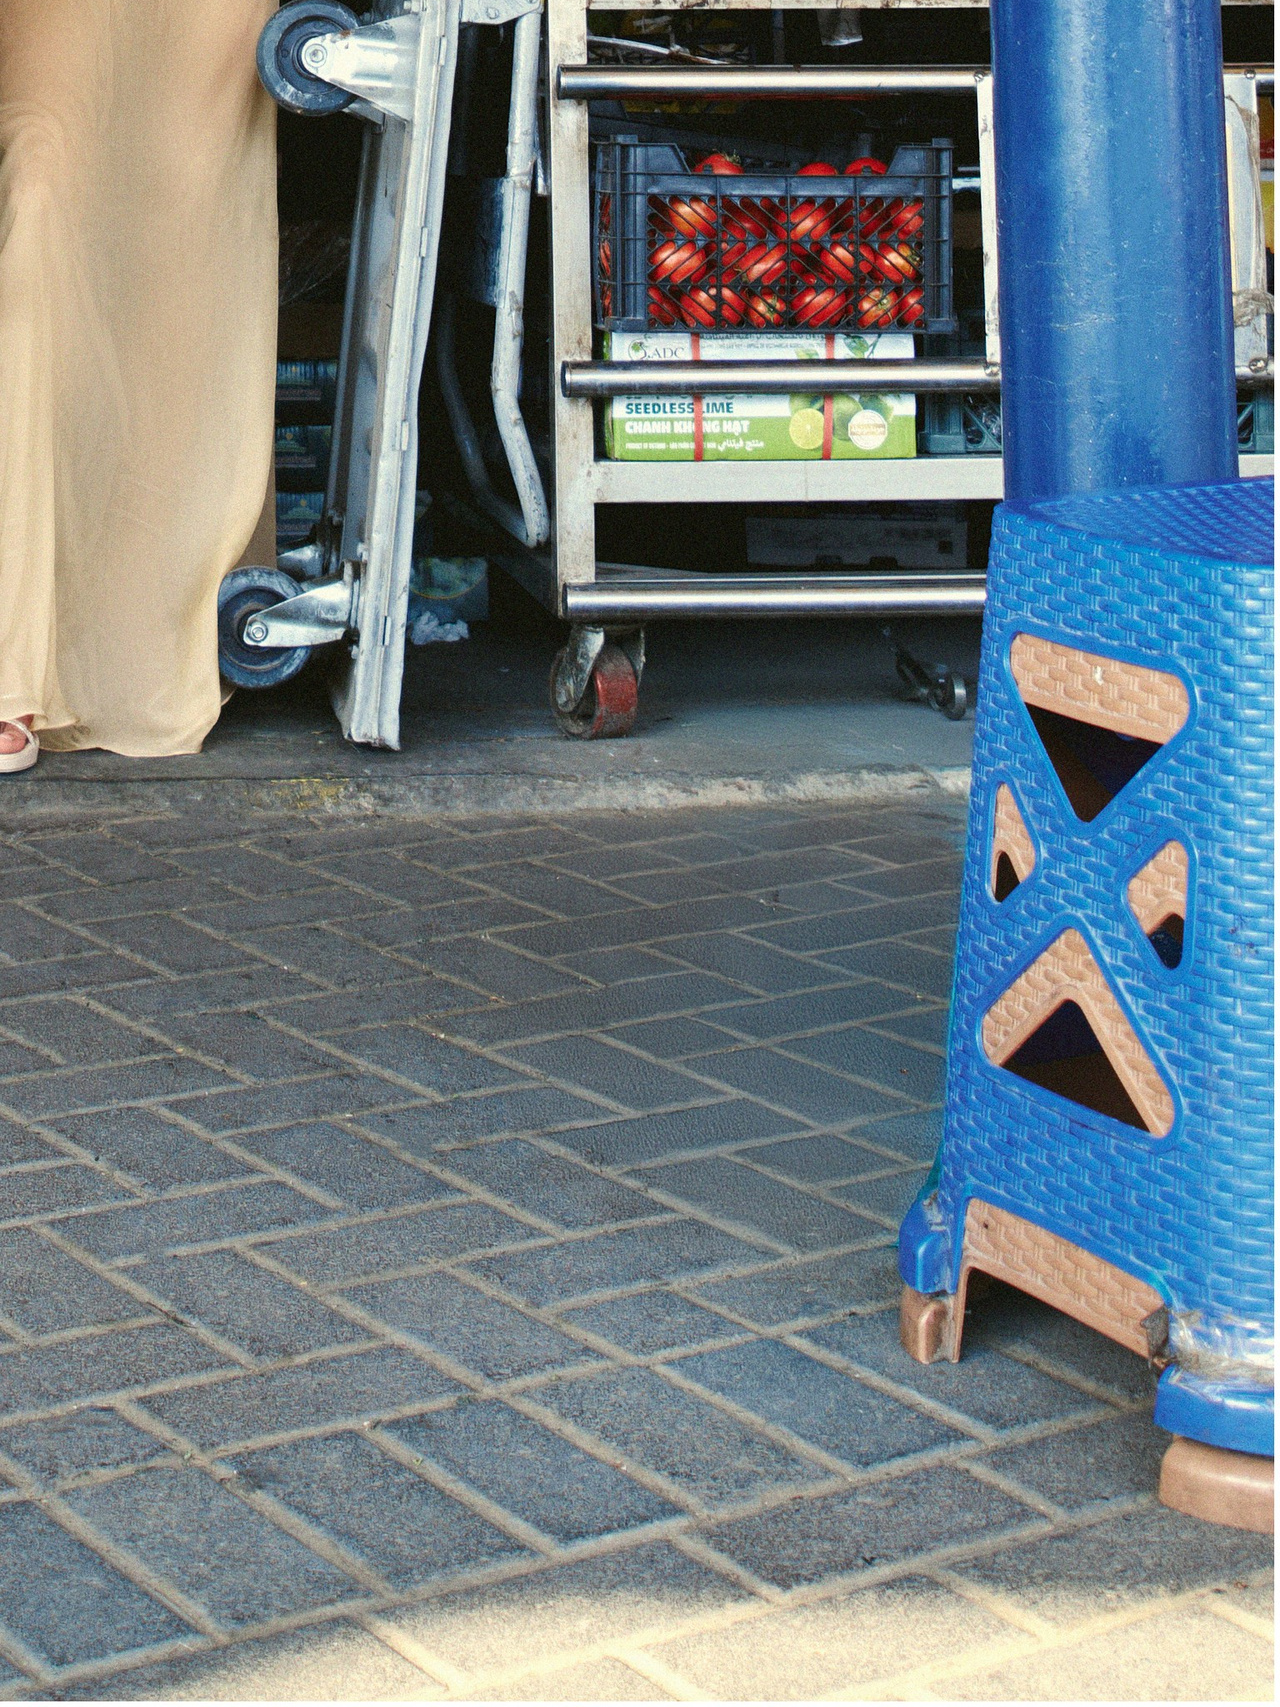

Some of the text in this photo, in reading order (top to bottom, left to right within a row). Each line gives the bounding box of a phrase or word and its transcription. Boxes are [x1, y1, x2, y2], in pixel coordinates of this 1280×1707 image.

[625, 402, 734, 414] SEEDLESS IME
[625, 420, 671, 434] CHANH
[673, 420, 720, 433] KHNG
